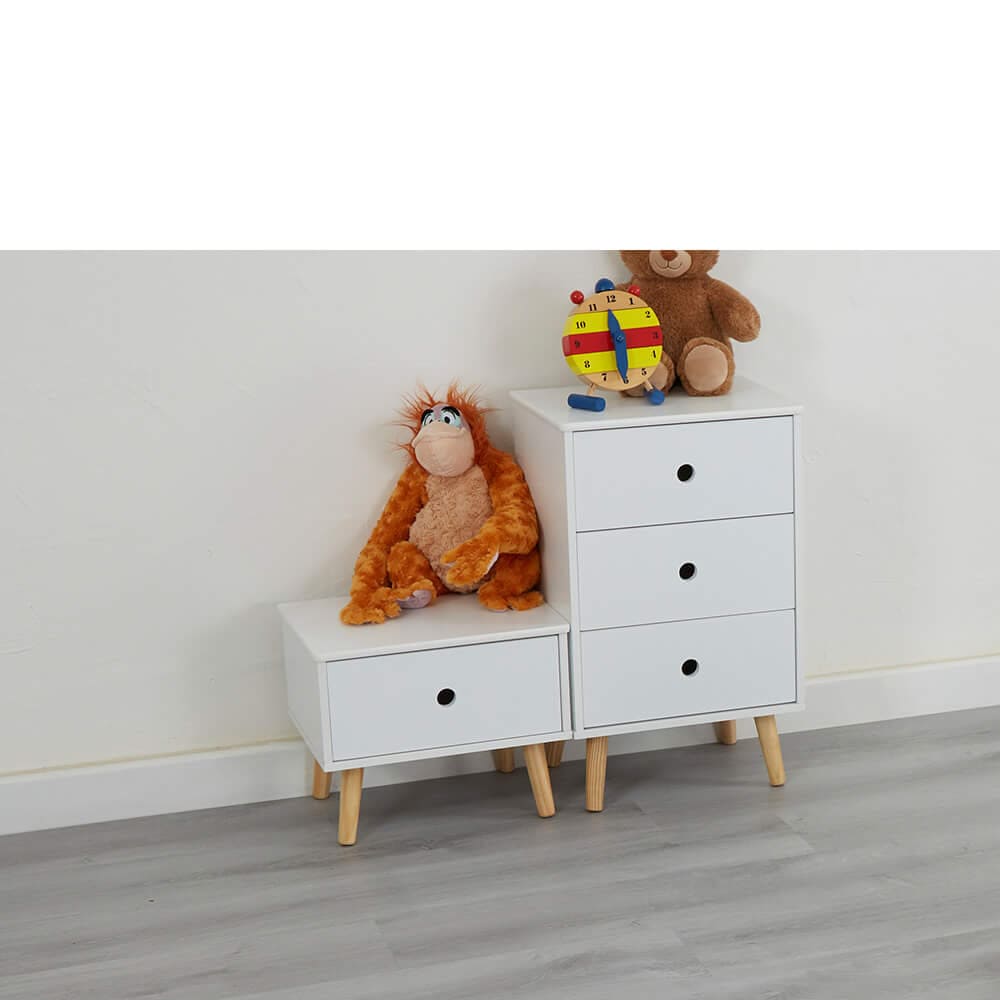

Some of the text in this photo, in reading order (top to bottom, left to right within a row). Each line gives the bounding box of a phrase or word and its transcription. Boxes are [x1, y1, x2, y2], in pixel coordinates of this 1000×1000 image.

[606, 295, 616, 303] 12
[589, 303, 597, 311] 11
[576, 321, 586, 329] 10
[651, 350, 657, 358] 4
[584, 360, 590, 368] 8
[641, 368, 647, 376] 5
[601, 373, 607, 381] 7
